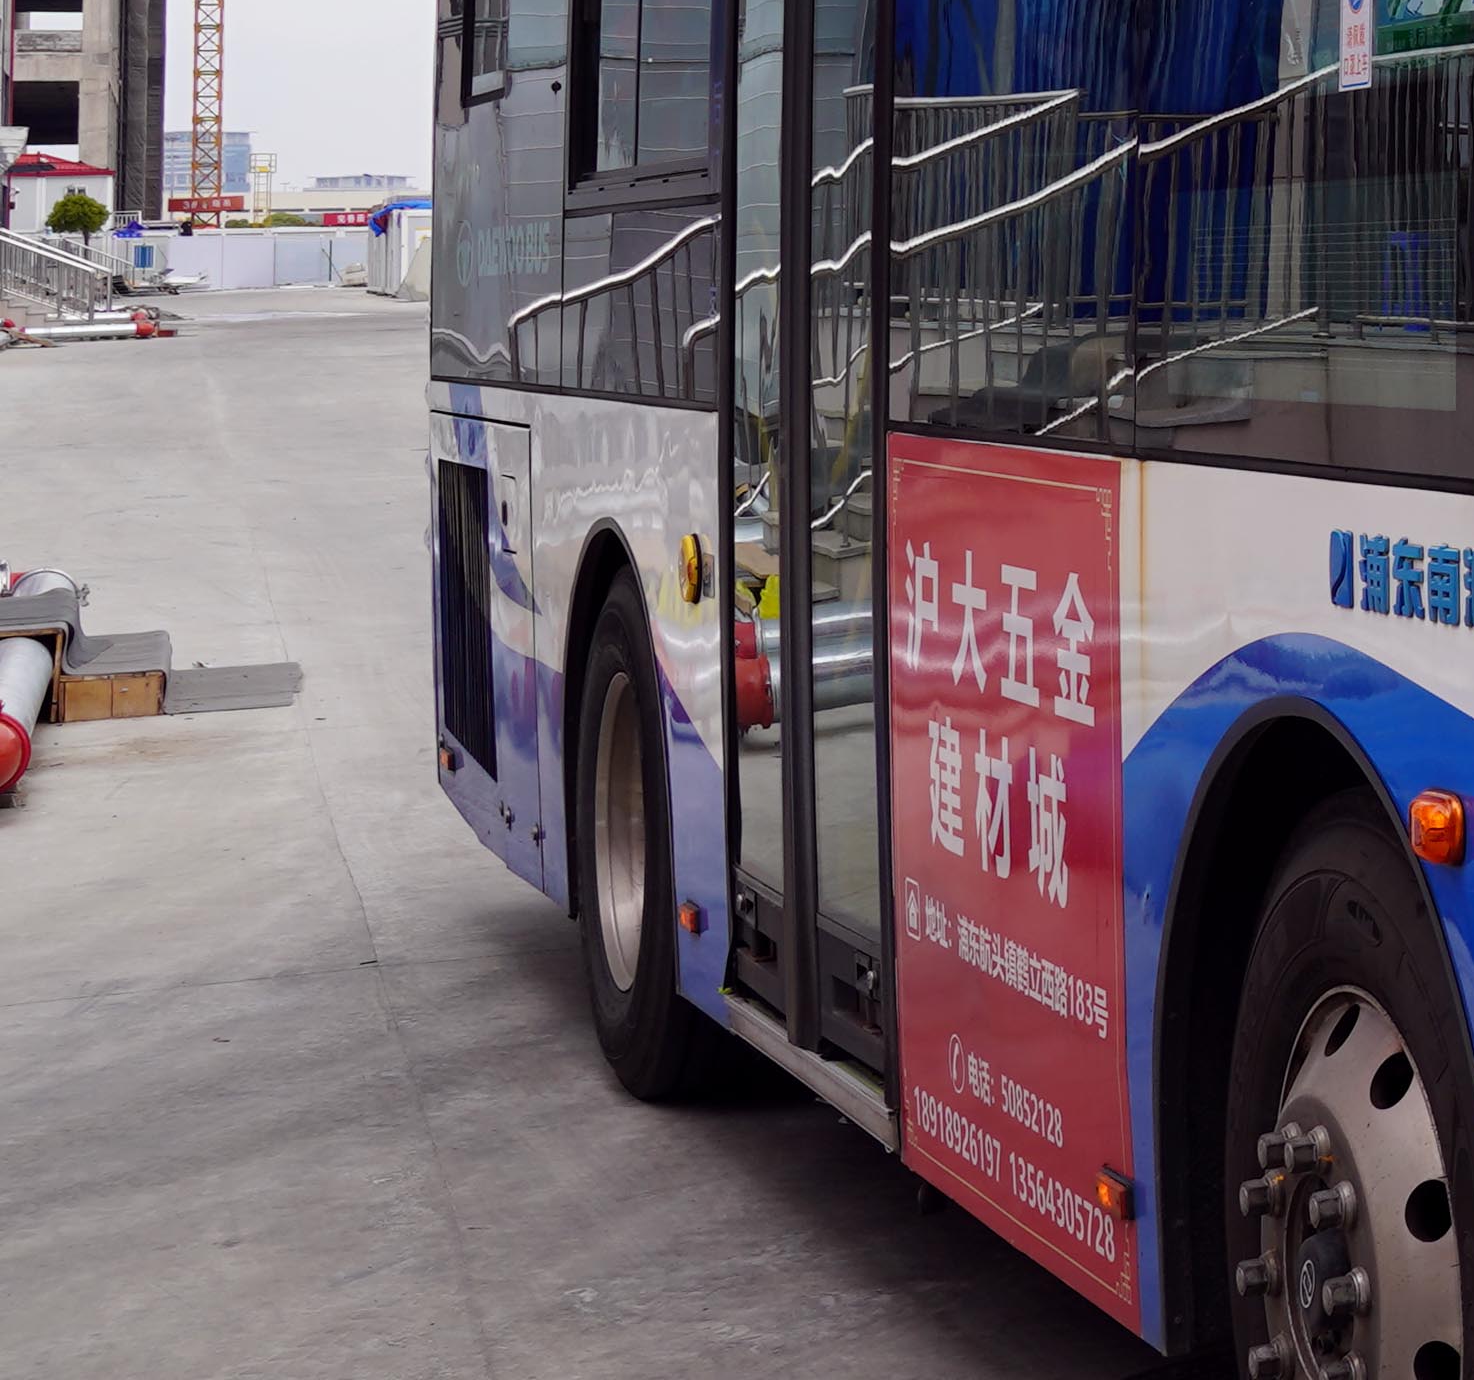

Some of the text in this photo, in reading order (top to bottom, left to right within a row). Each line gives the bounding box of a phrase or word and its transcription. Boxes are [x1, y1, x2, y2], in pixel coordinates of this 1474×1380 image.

[905, 539, 1096, 727] 沪大五金
[928, 716, 1069, 909] 建材城
[913, 1085, 1115, 1263] 18918926197 13564305728
